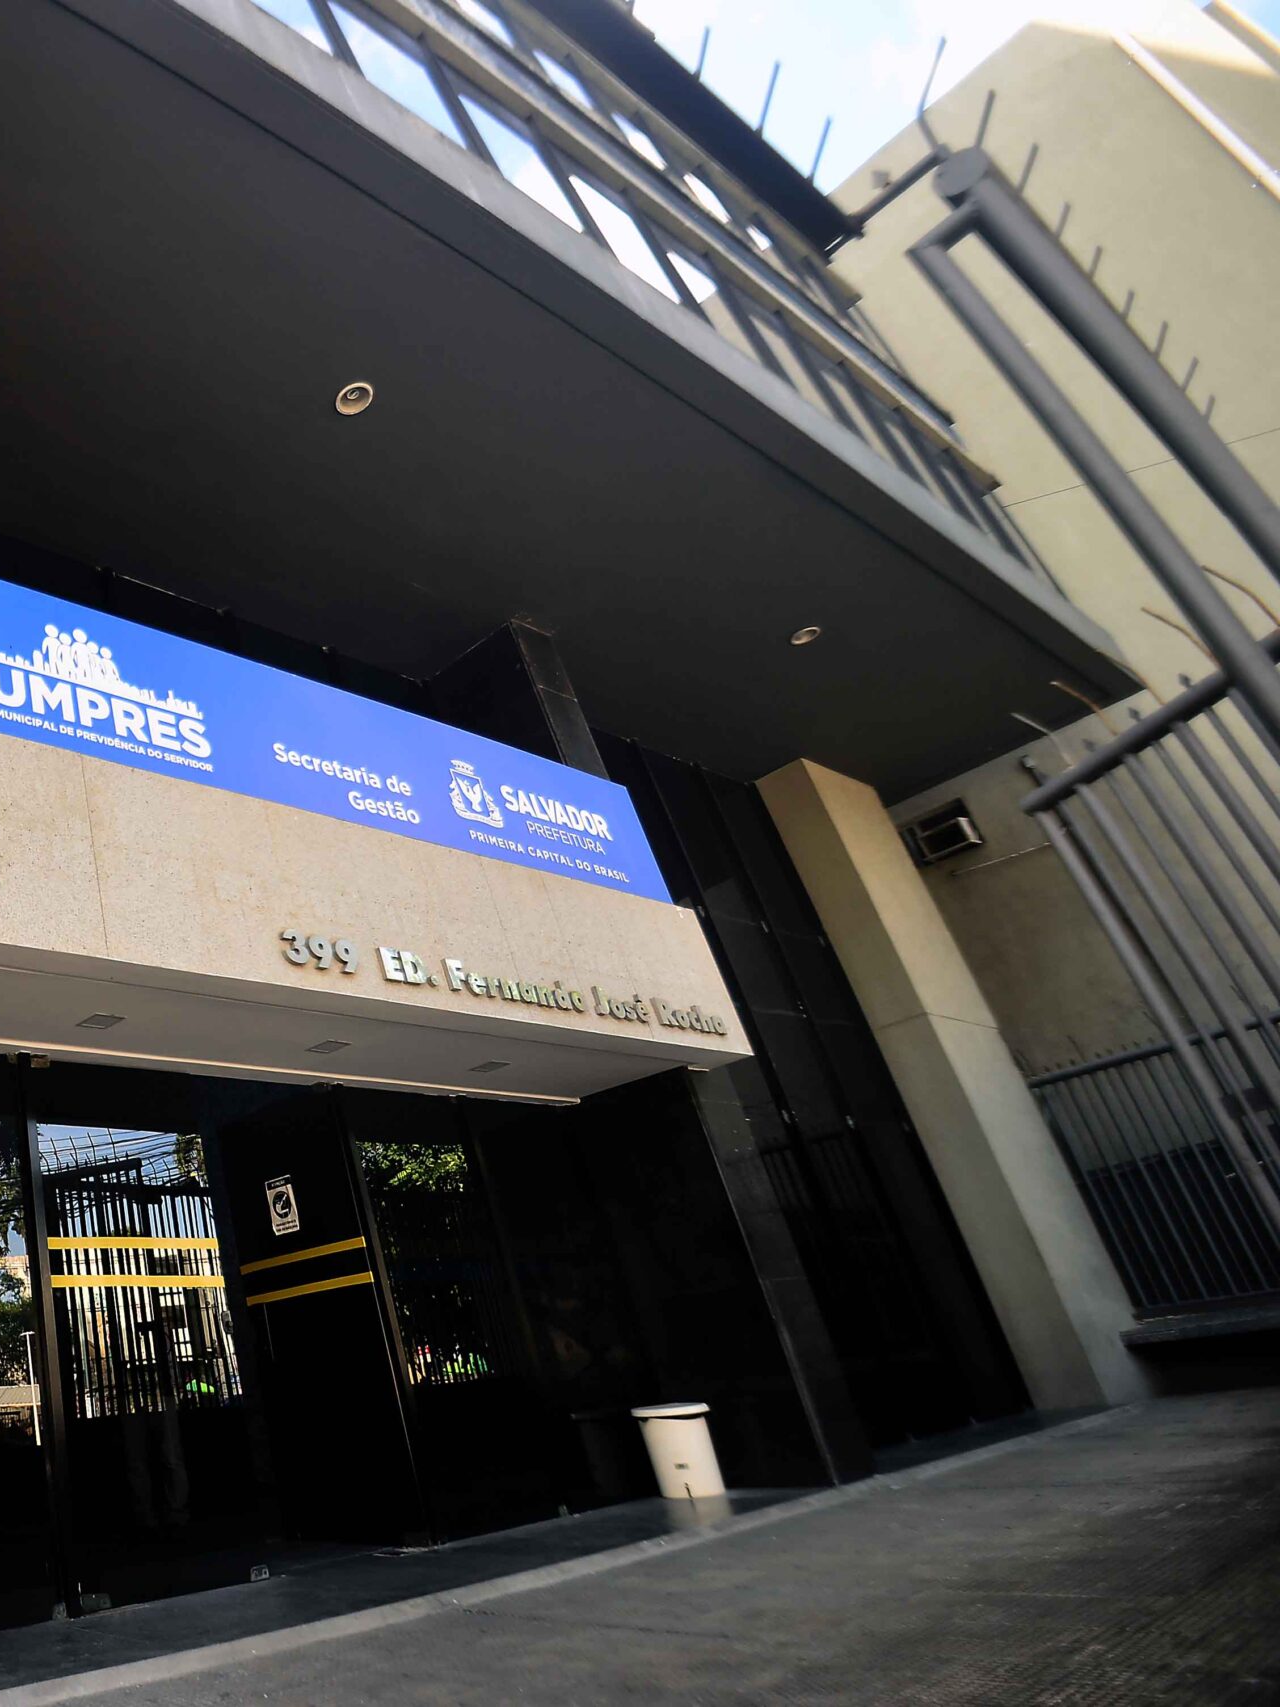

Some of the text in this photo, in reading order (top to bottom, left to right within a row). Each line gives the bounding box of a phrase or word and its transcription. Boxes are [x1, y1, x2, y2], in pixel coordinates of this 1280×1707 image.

[59, 724, 75, 736] DE
[76, 729, 146, 755] PREVIDÊNCIA
[147, 748, 163, 759] DO
[163, 753, 214, 772] SERVIDOR
[272, 743, 413, 797] Secretaria de
[348, 791, 420, 824] Gestão
[500, 785, 613, 841] SALVADOR
[469, 829, 630, 883] PRIMEIRA CAPITAL DO BRASIL
[526, 820, 606, 855] PREFEITURA
[280, 928, 728, 1035] 399 ED. Fernando José Rocha
